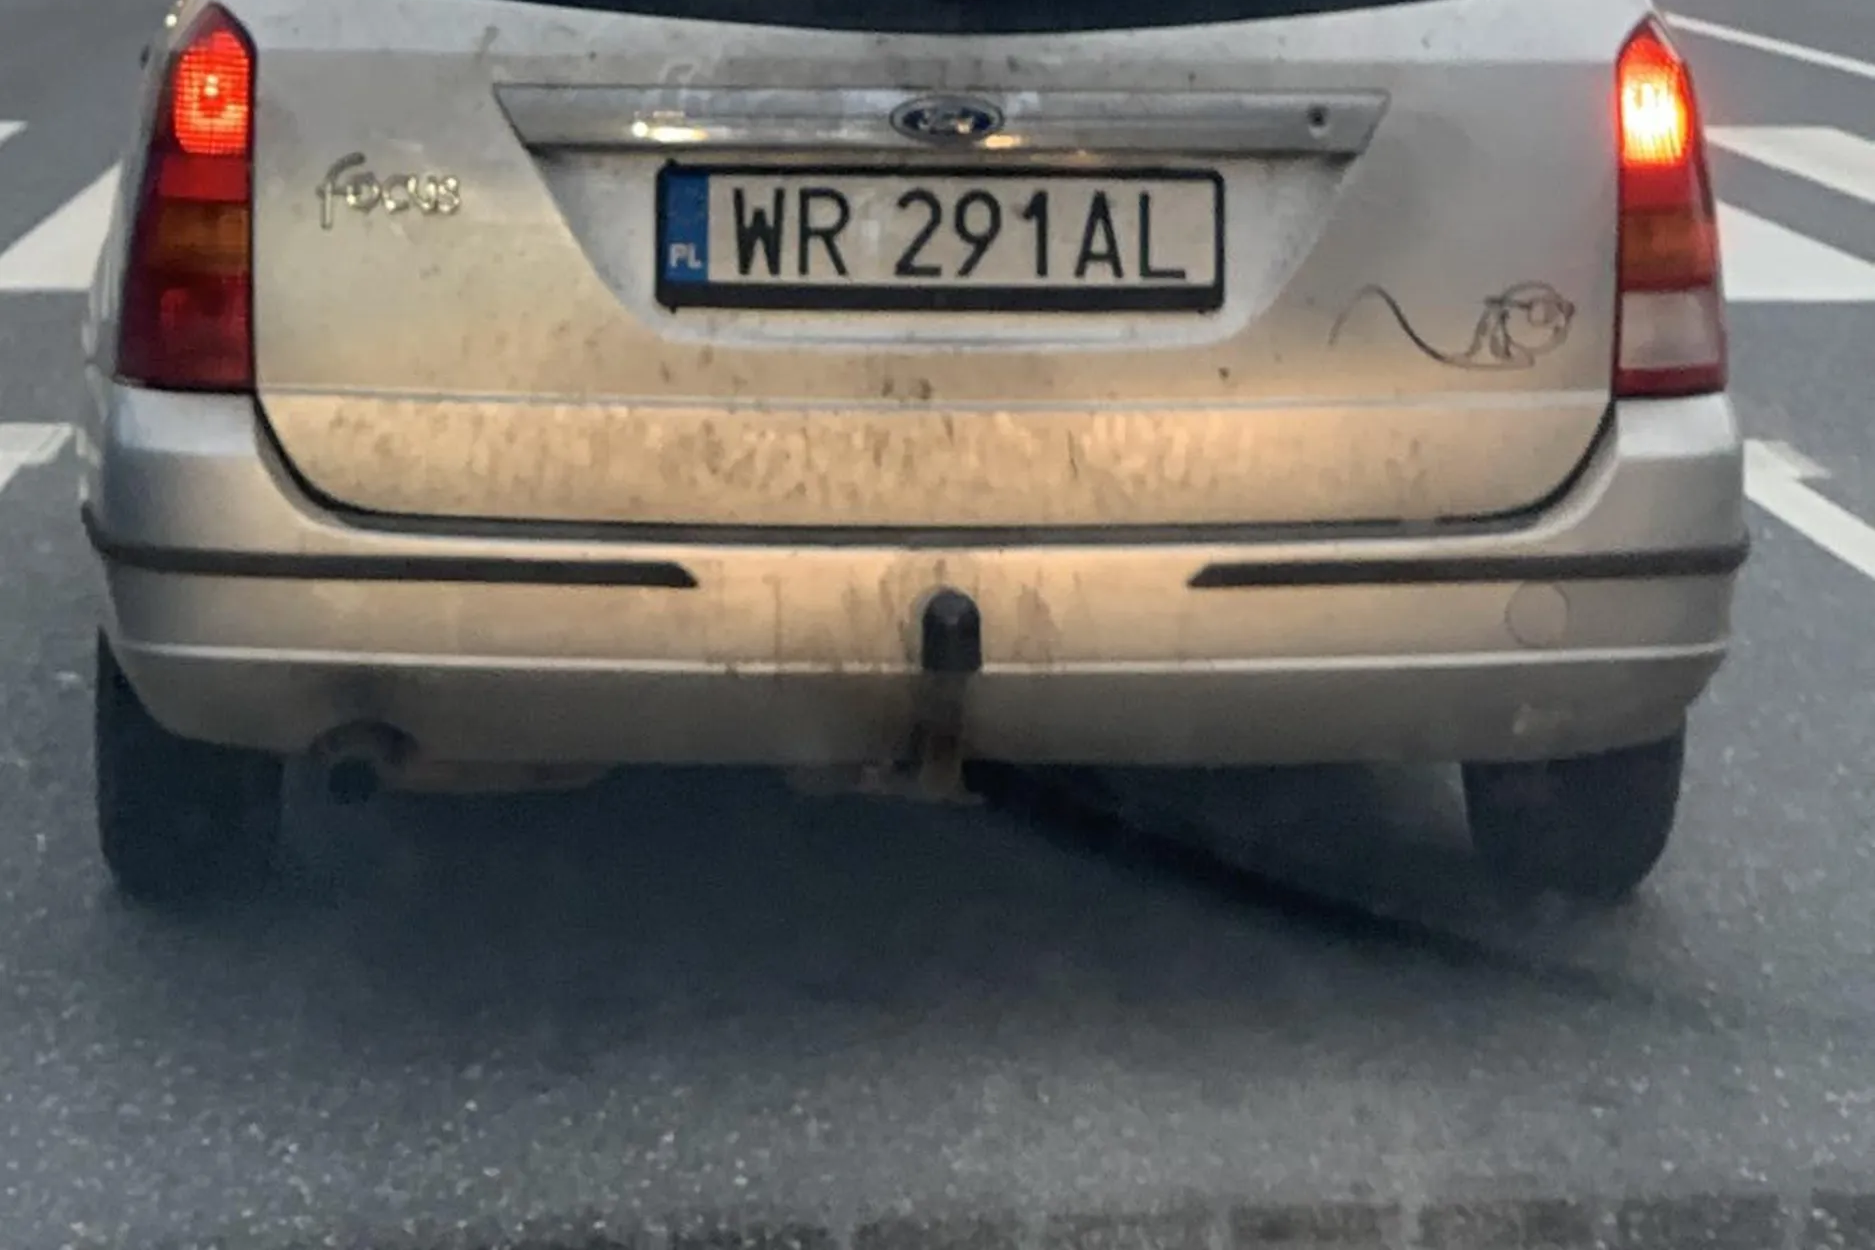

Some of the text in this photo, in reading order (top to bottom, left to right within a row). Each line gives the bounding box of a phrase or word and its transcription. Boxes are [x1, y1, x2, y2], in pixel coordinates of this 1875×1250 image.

[670, 243, 702, 269] PL
[733, 187, 1187, 279] WR 291AL
